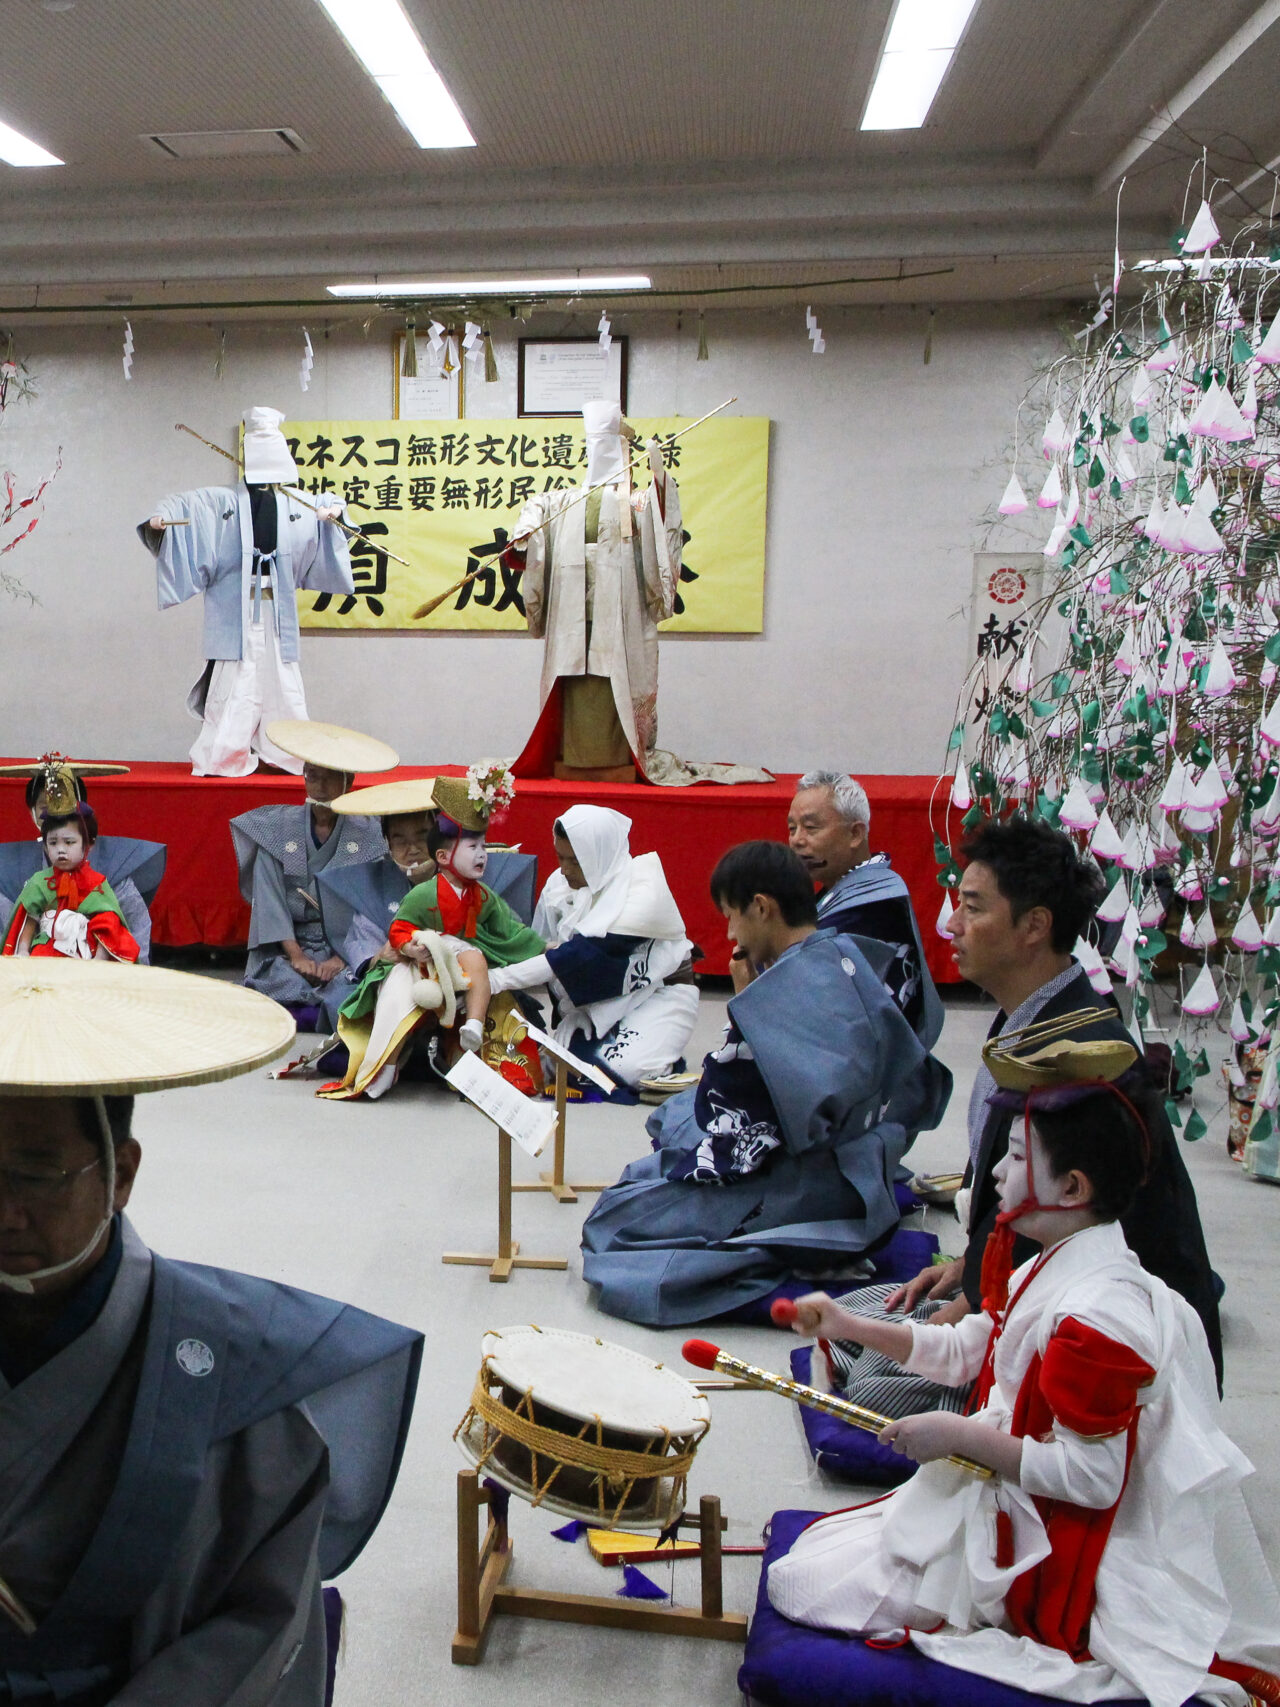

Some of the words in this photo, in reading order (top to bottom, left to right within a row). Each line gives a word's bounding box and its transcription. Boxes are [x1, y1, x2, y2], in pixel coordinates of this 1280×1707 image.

[284, 431, 681, 471] ユネスコ無形文化遺録
